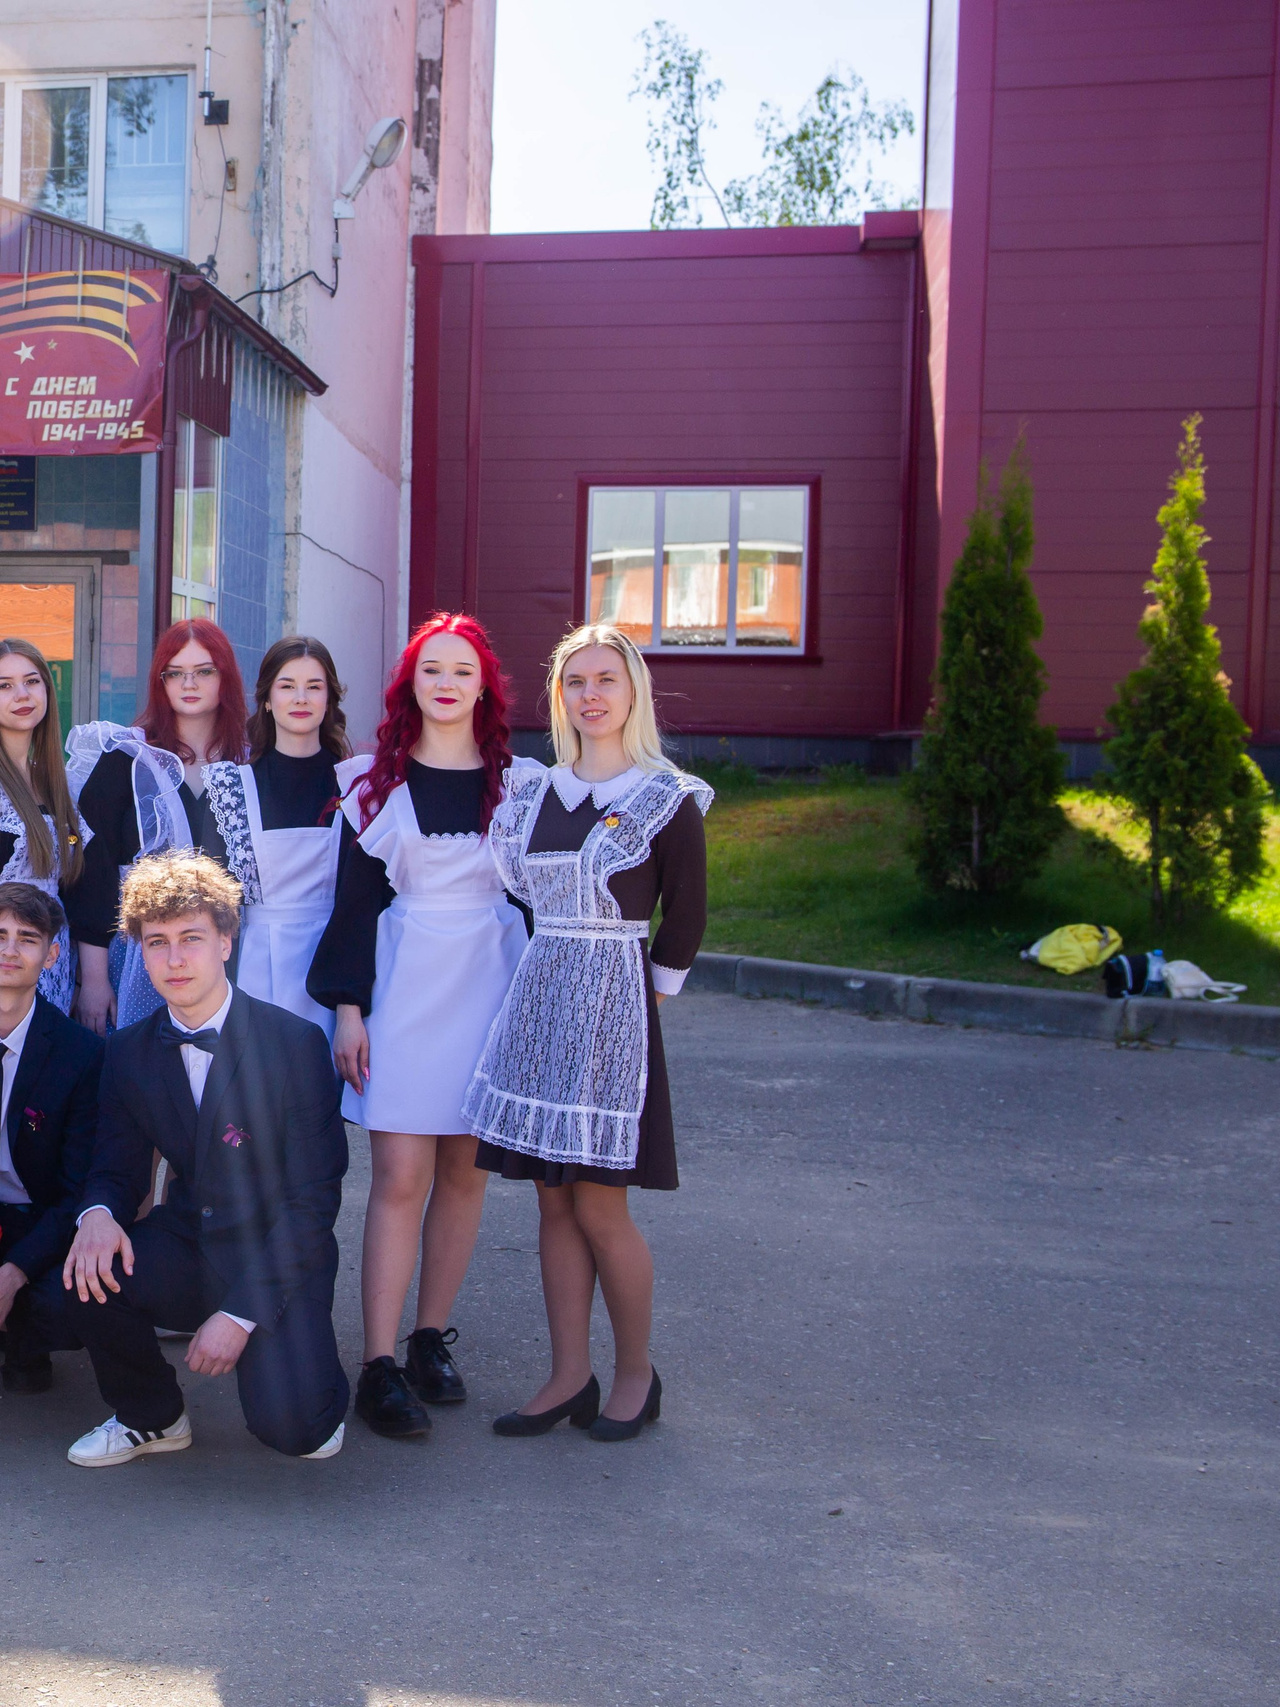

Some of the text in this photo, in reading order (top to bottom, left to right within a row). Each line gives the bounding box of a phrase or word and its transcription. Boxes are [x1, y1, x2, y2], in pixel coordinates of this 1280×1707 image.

[5, 375, 97, 396] С ДНЕМ
[26, 398, 134, 420] ПОБЕДЫ!
